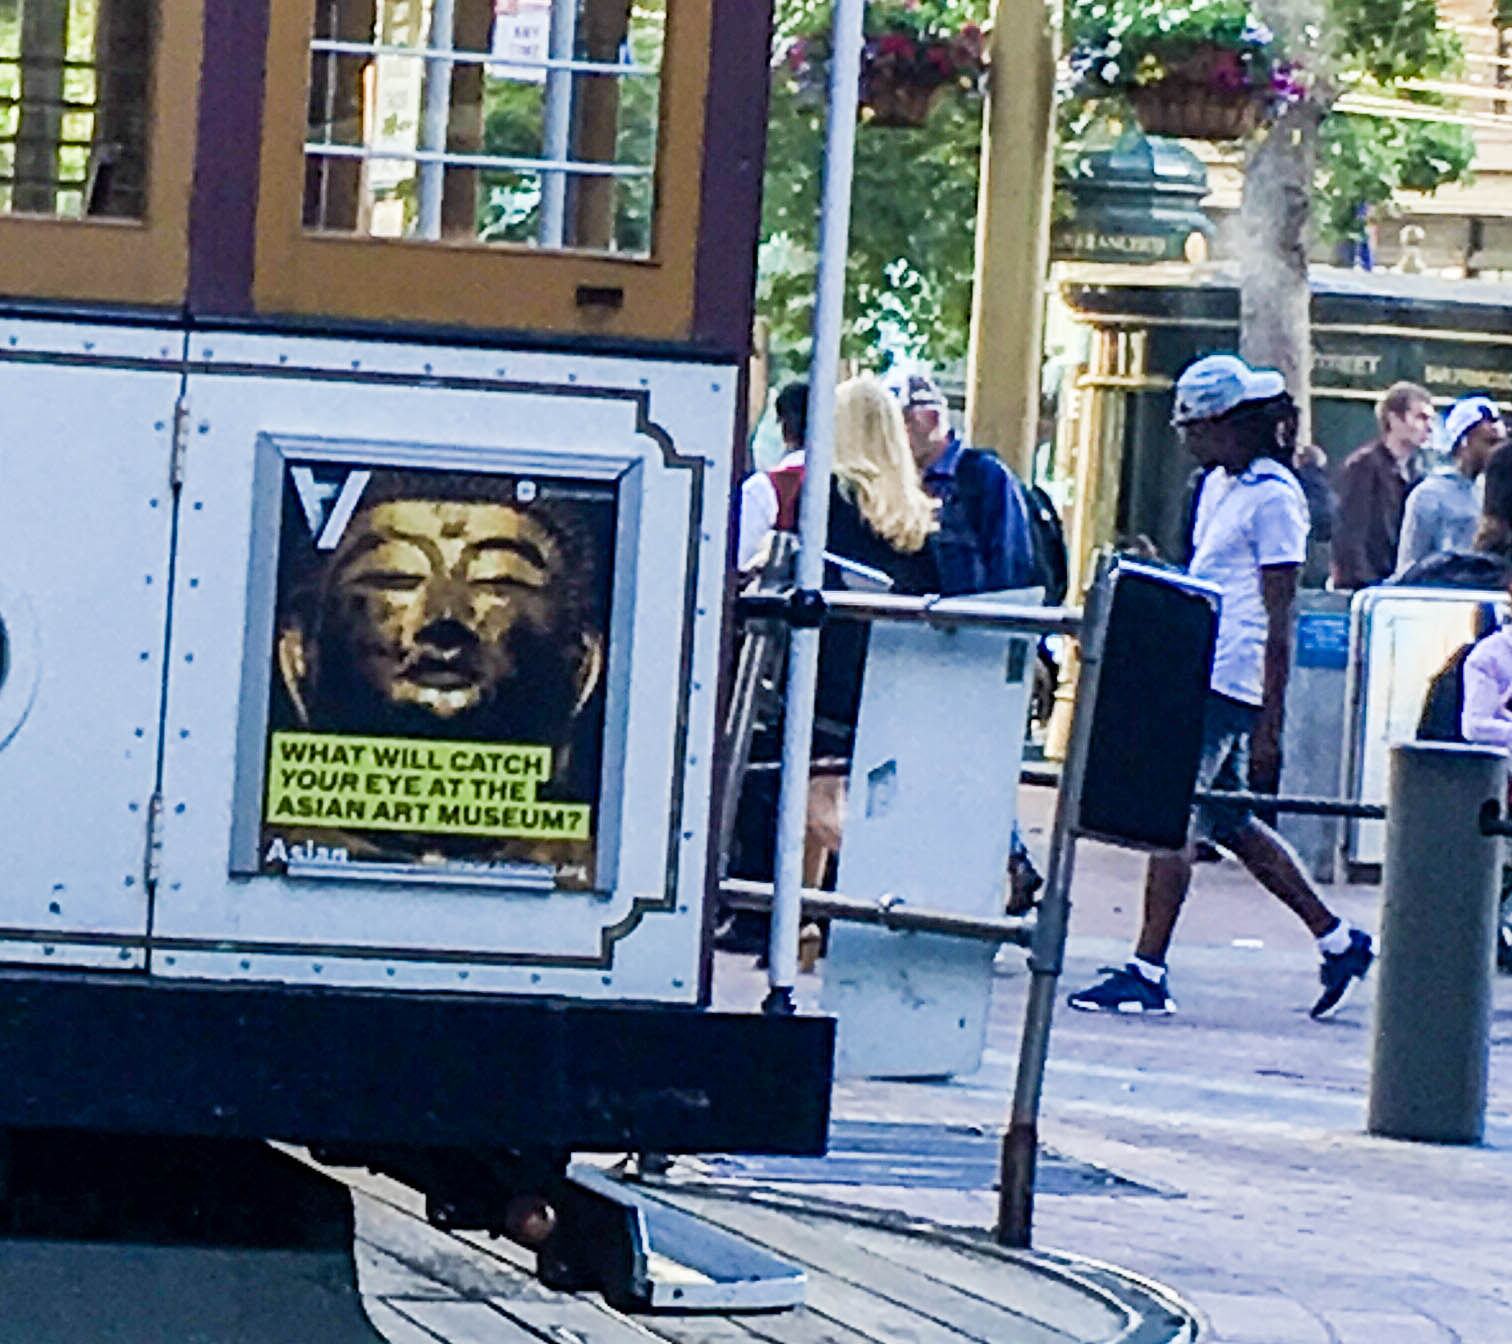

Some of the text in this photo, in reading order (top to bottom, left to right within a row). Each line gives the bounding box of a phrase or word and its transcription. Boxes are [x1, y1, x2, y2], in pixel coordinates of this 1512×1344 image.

[280, 742, 541, 774] WHAT WILL CATCH
[281, 769, 526, 801] YOUR EYE AT THE
[275, 795, 583, 831] ASIAN ART MUSEUM?
[266, 838, 348, 863] Asian
